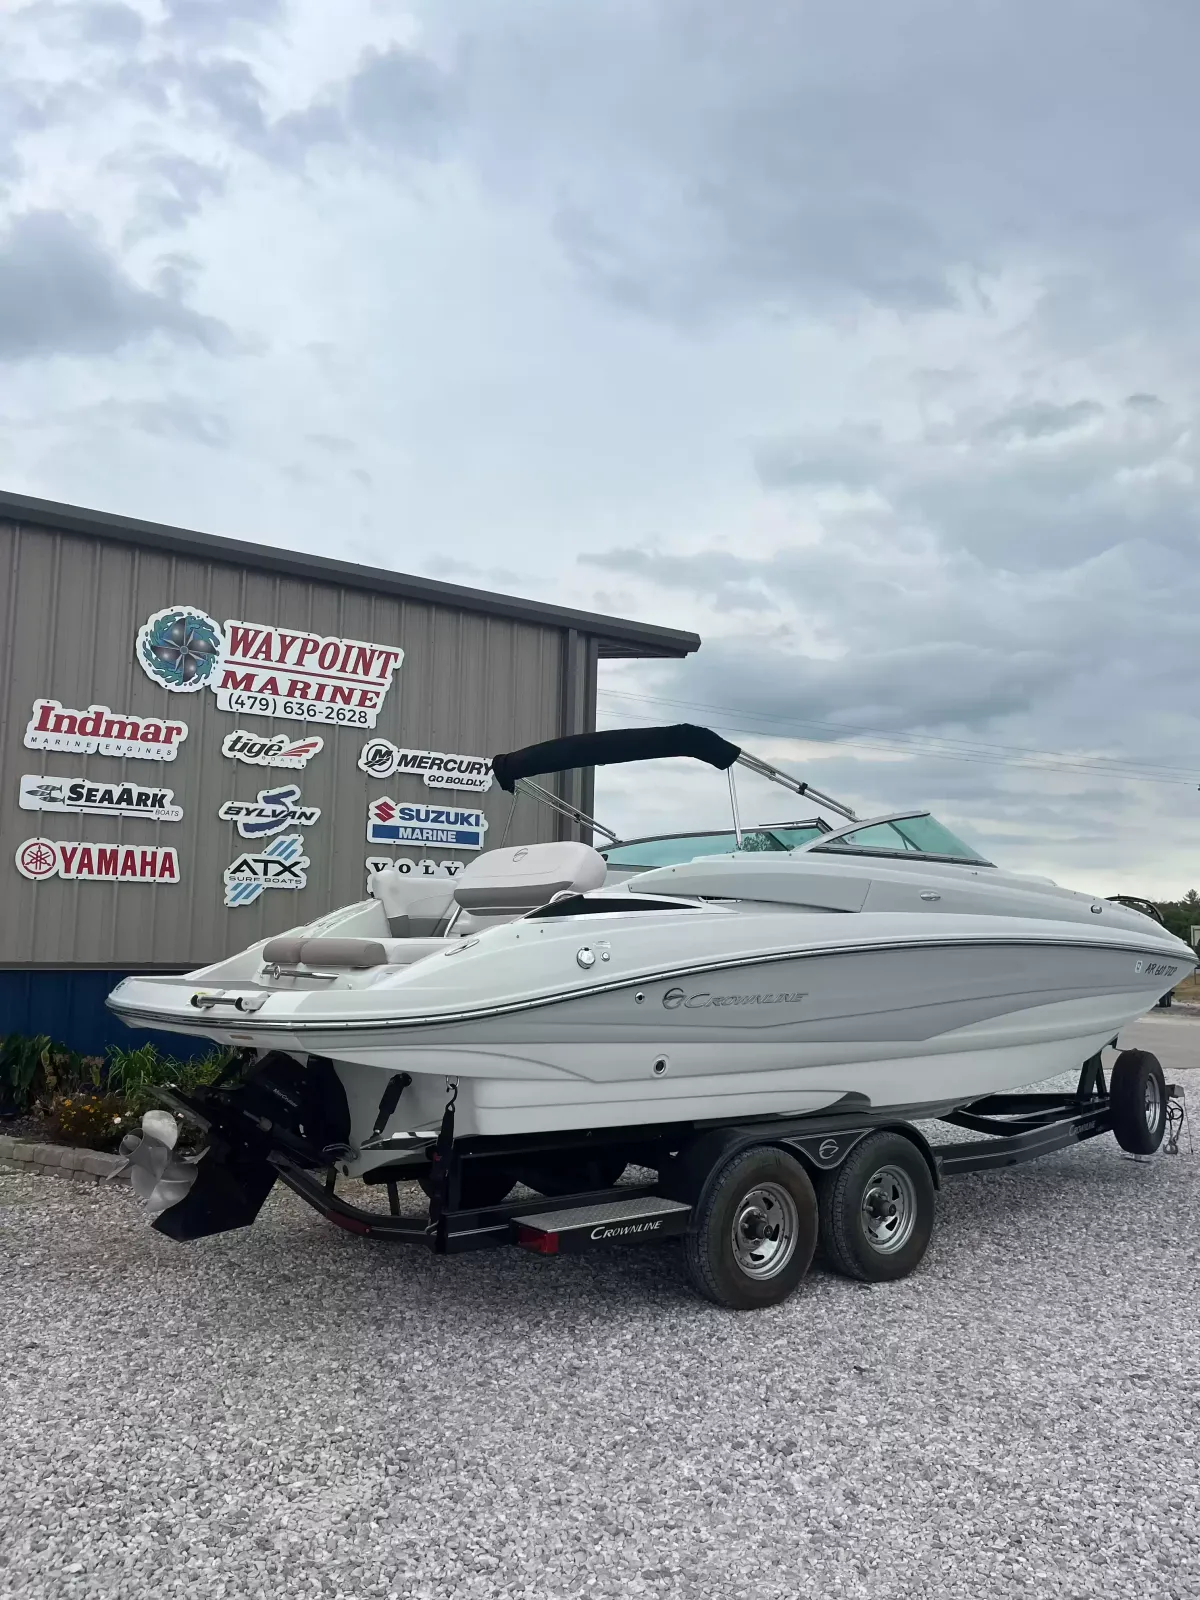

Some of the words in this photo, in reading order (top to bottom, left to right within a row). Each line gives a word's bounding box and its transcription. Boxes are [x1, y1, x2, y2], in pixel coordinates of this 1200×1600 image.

[230, 626, 399, 679] WAYPOINT
[217, 669, 381, 709] MARINE
[228, 693, 277, 715] (479)
[283, 700, 368, 724] 636-2628
[34, 705, 182, 744] Indmar
[30, 736, 92, 749] MARINE
[105, 744, 172, 756] ENGINES
[397, 753, 493, 776] MERCURY
[428, 775, 444, 783] GO
[155, 809, 180, 817] BOATS
[224, 806, 316, 820] SYLVAN
[398, 807, 480, 827] SUZUKI
[398, 827, 457, 842] MARINE
[60, 846, 175, 878] YAMAHA
[230, 859, 302, 877] ATX
[371, 862, 460, 876] VOLV
[228, 875, 261, 883] SURF
[264, 877, 302, 885] BOATS
[590, 1220, 663, 1240] CROWNLINE
